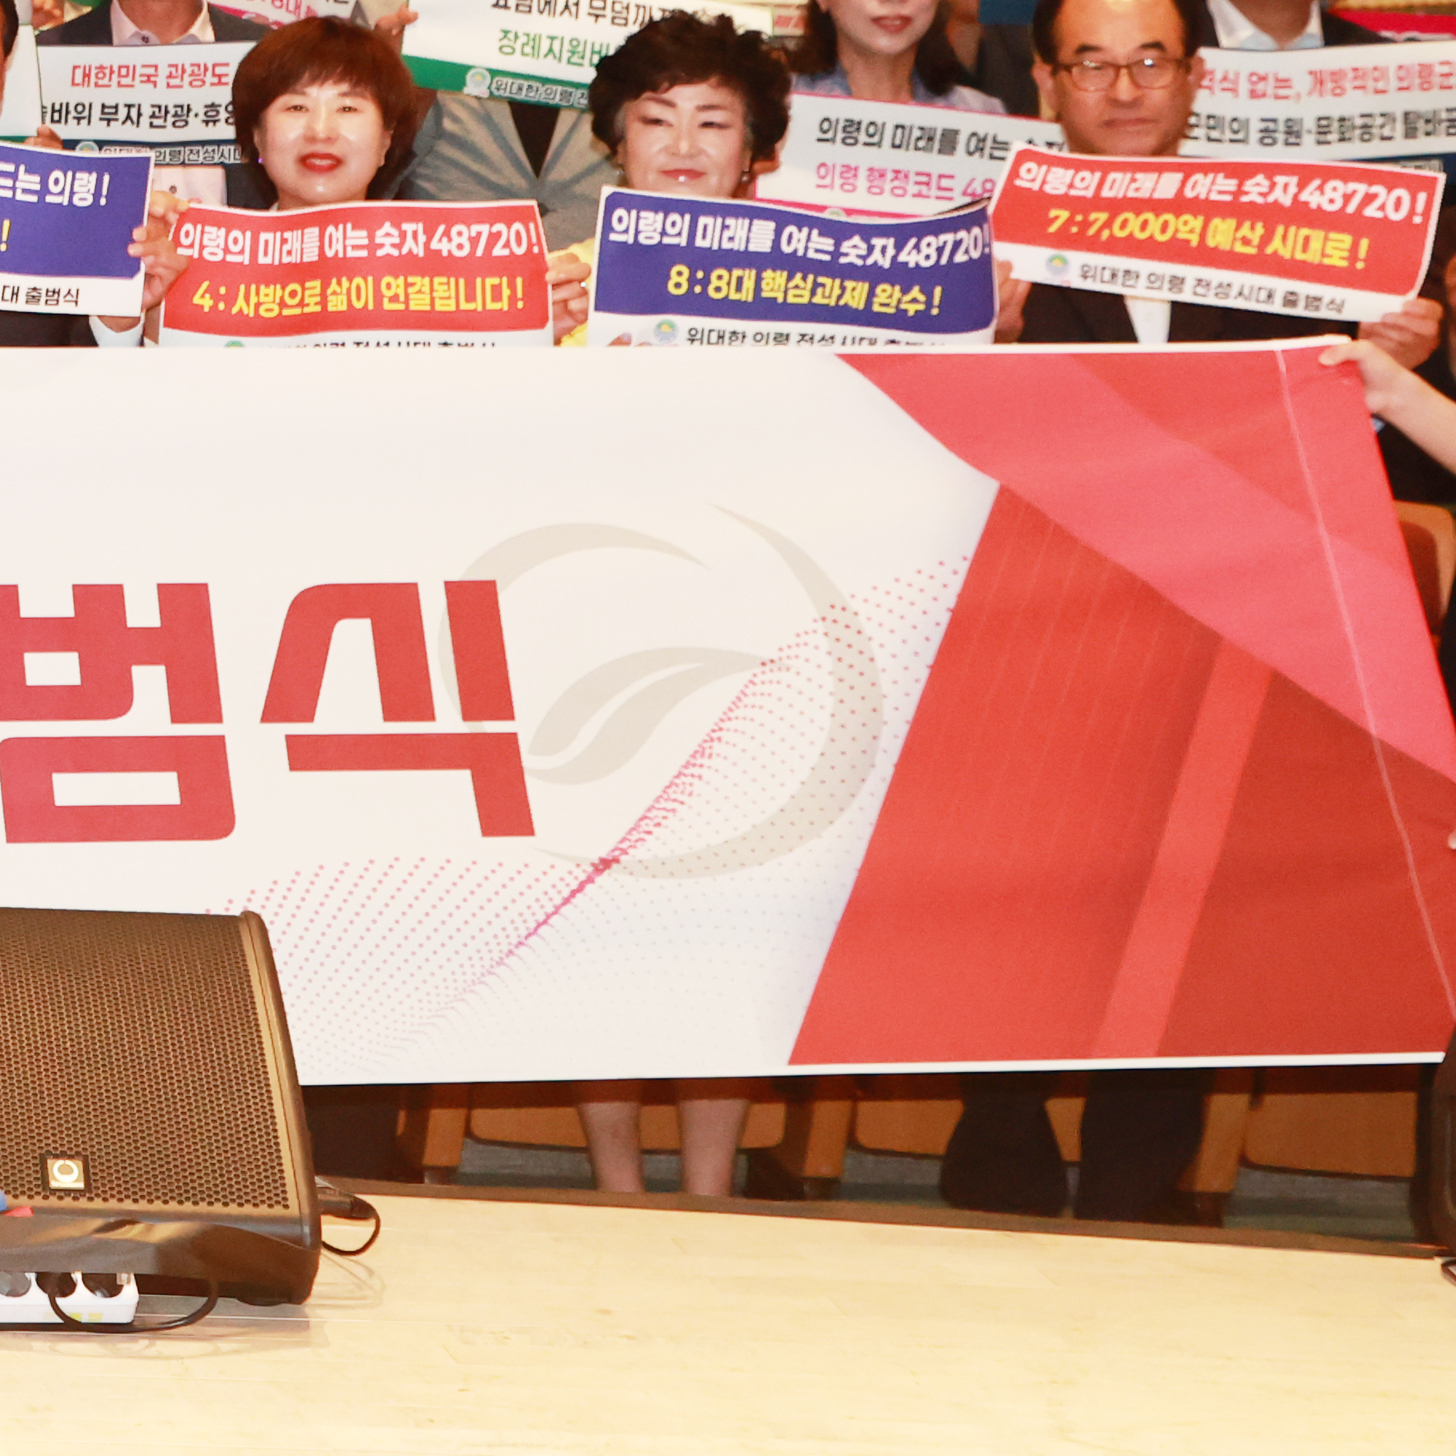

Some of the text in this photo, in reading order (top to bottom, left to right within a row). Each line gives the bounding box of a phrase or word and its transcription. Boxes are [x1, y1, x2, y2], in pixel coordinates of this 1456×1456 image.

[71, 64, 158, 89] 대한민국
[1307, 65, 1388, 96] 개방적인
[99, 102, 143, 127] 부자
[817, 118, 958, 153] 의령의 미래를
[817, 162, 954, 199] 의령 행정코드
[1015, 163, 1093, 196] 의령의
[1102, 166, 1177, 198] 미래를
[1184, 172, 1235, 199] 여는
[1243, 174, 1296, 204] 숫자
[179, 225, 250, 262] 의령의
[258, 225, 320, 263] 미래를
[324, 223, 368, 259] 여는
[376, 223, 424, 256] 숫자
[612, 209, 685, 245] 의령의
[696, 213, 775, 251] 미래를
[782, 229, 833, 259] 여는
[841, 236, 893, 269] 숫자
[1207, 214, 1261, 253] 예산
[236, 280, 321, 318] 사방으로
[329, 280, 373, 312] 삶이
[760, 275, 869, 307] 핵심과제
